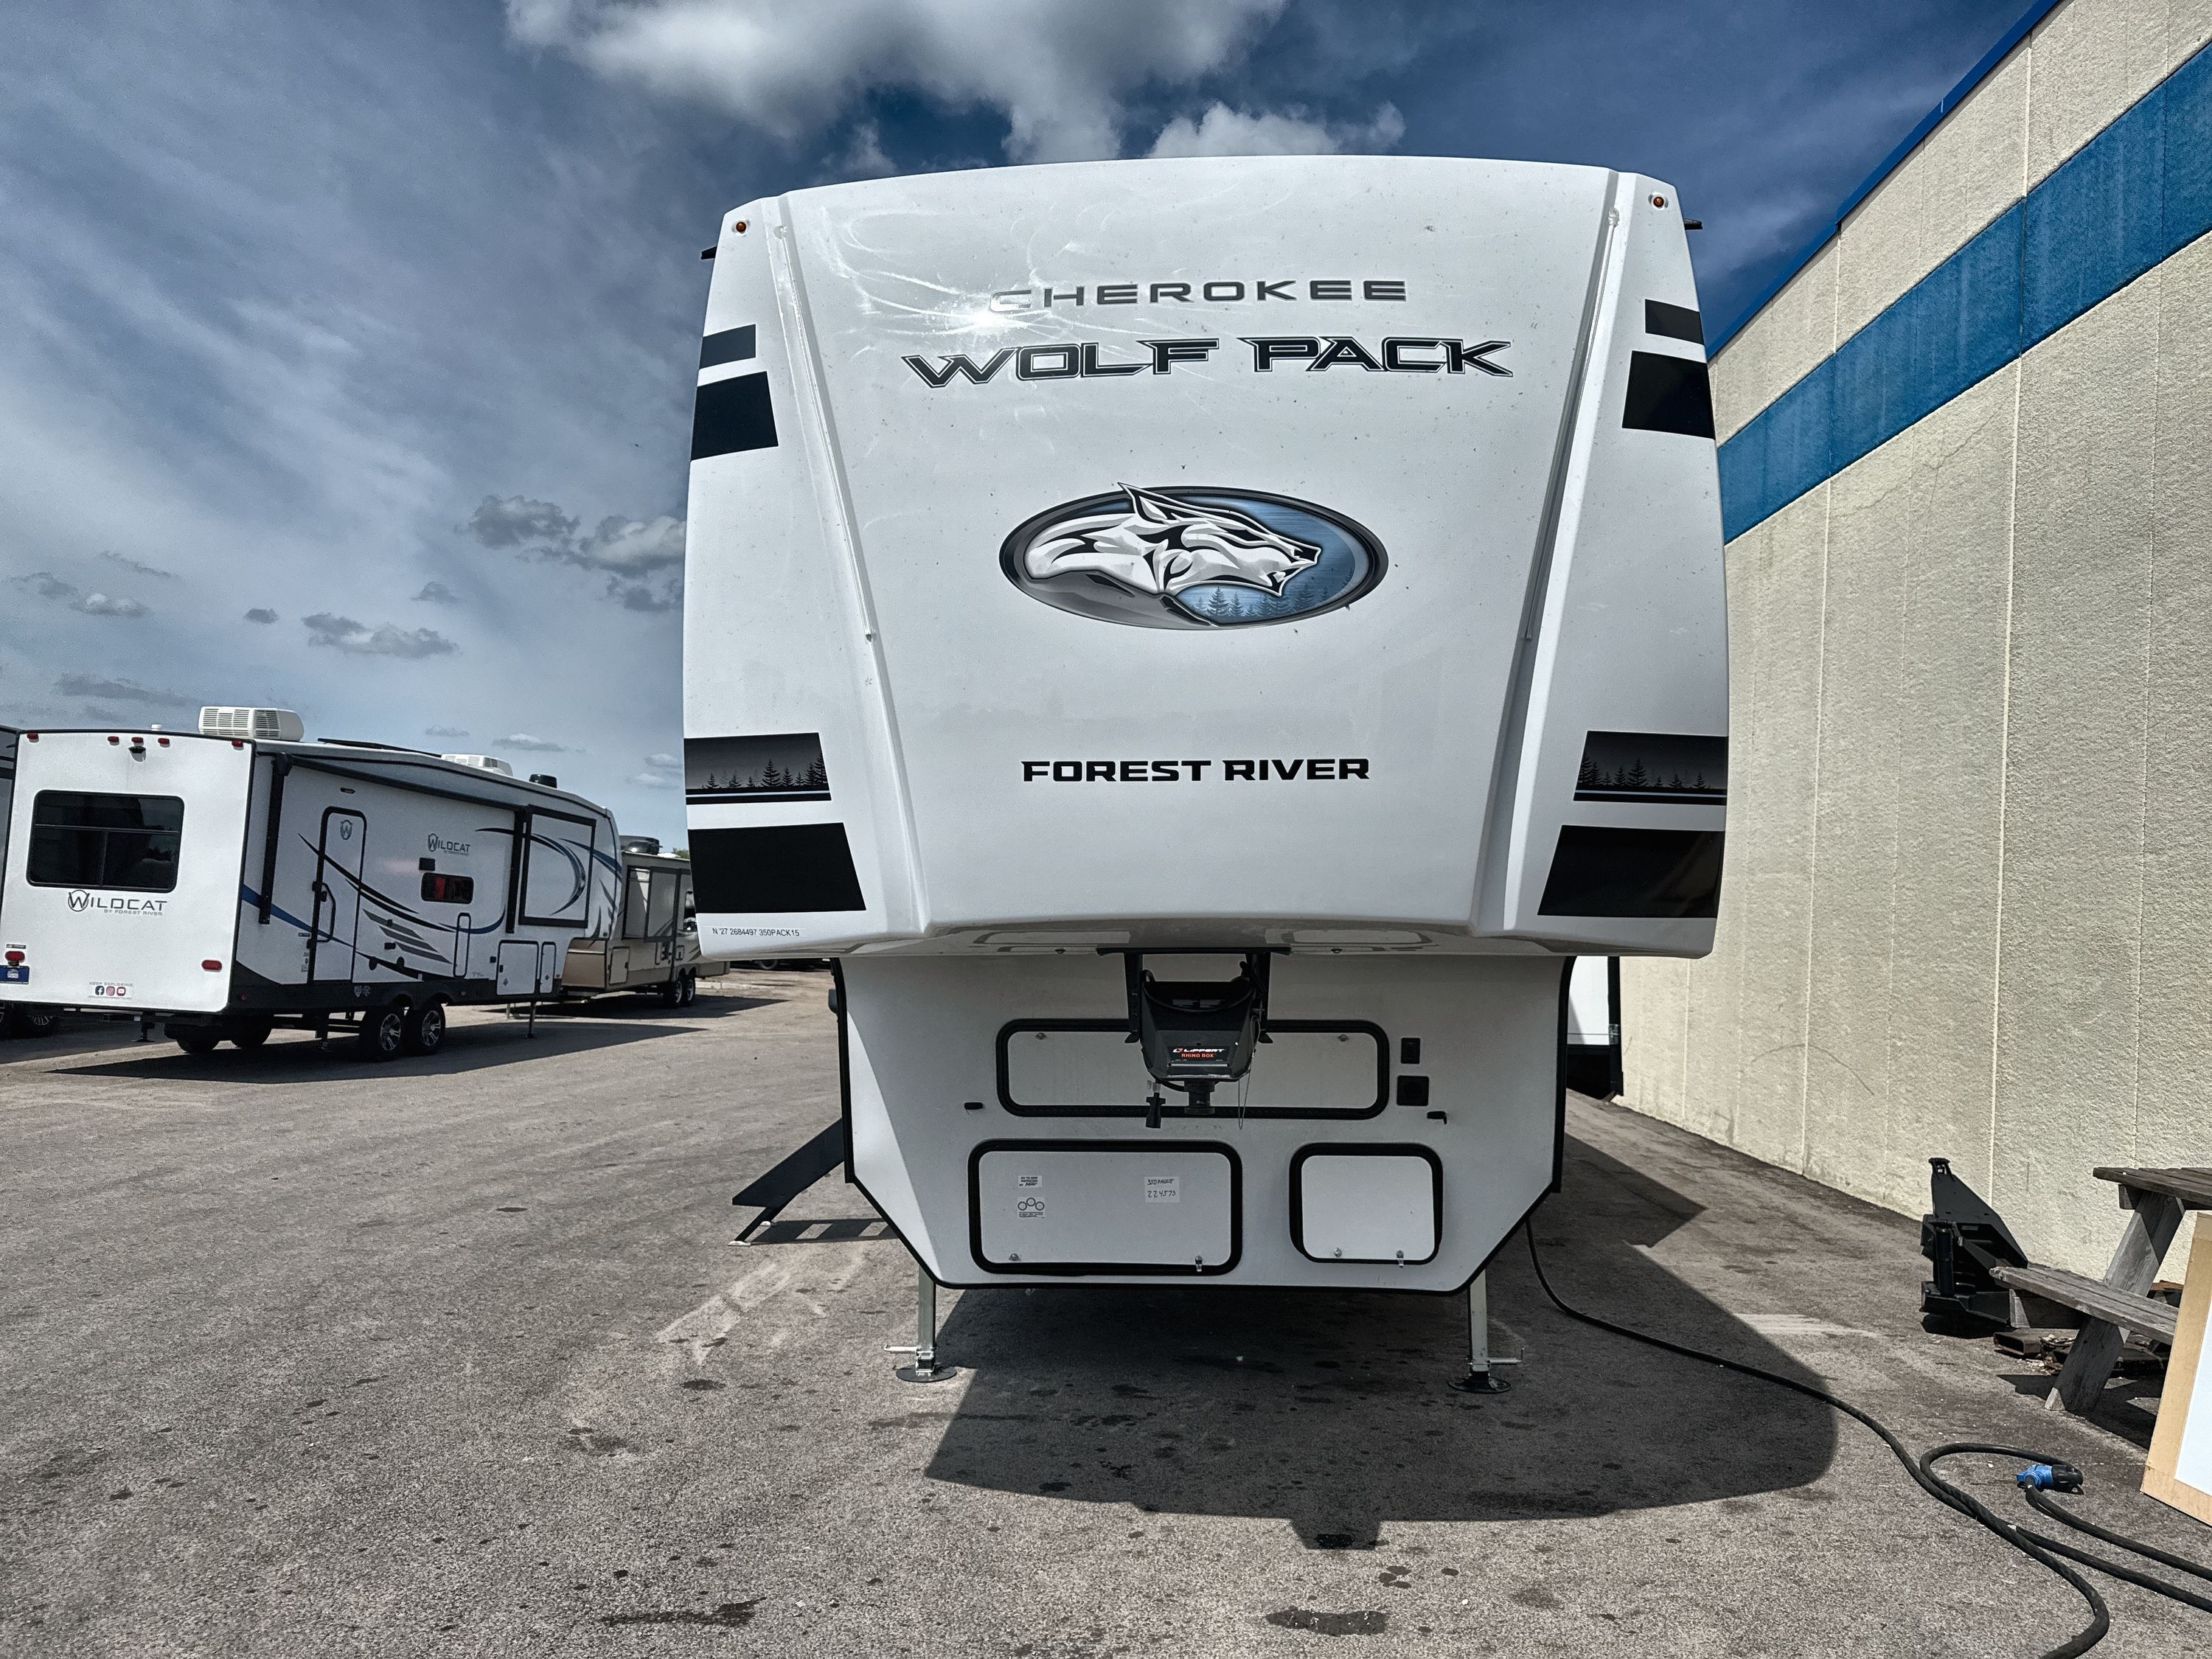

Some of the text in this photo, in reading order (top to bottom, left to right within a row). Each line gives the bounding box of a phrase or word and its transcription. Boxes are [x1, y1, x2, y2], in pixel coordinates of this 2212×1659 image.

[989, 279, 1407, 313] CHEROKEE
[901, 336, 1514, 388] WOLF PACK
[1020, 758, 1370, 782] FOREST RIVER
[428, 833, 470, 853] WILDCAT
[68, 889, 167, 912] WILDCAT
[759, 929, 800, 937] 350PACK15
